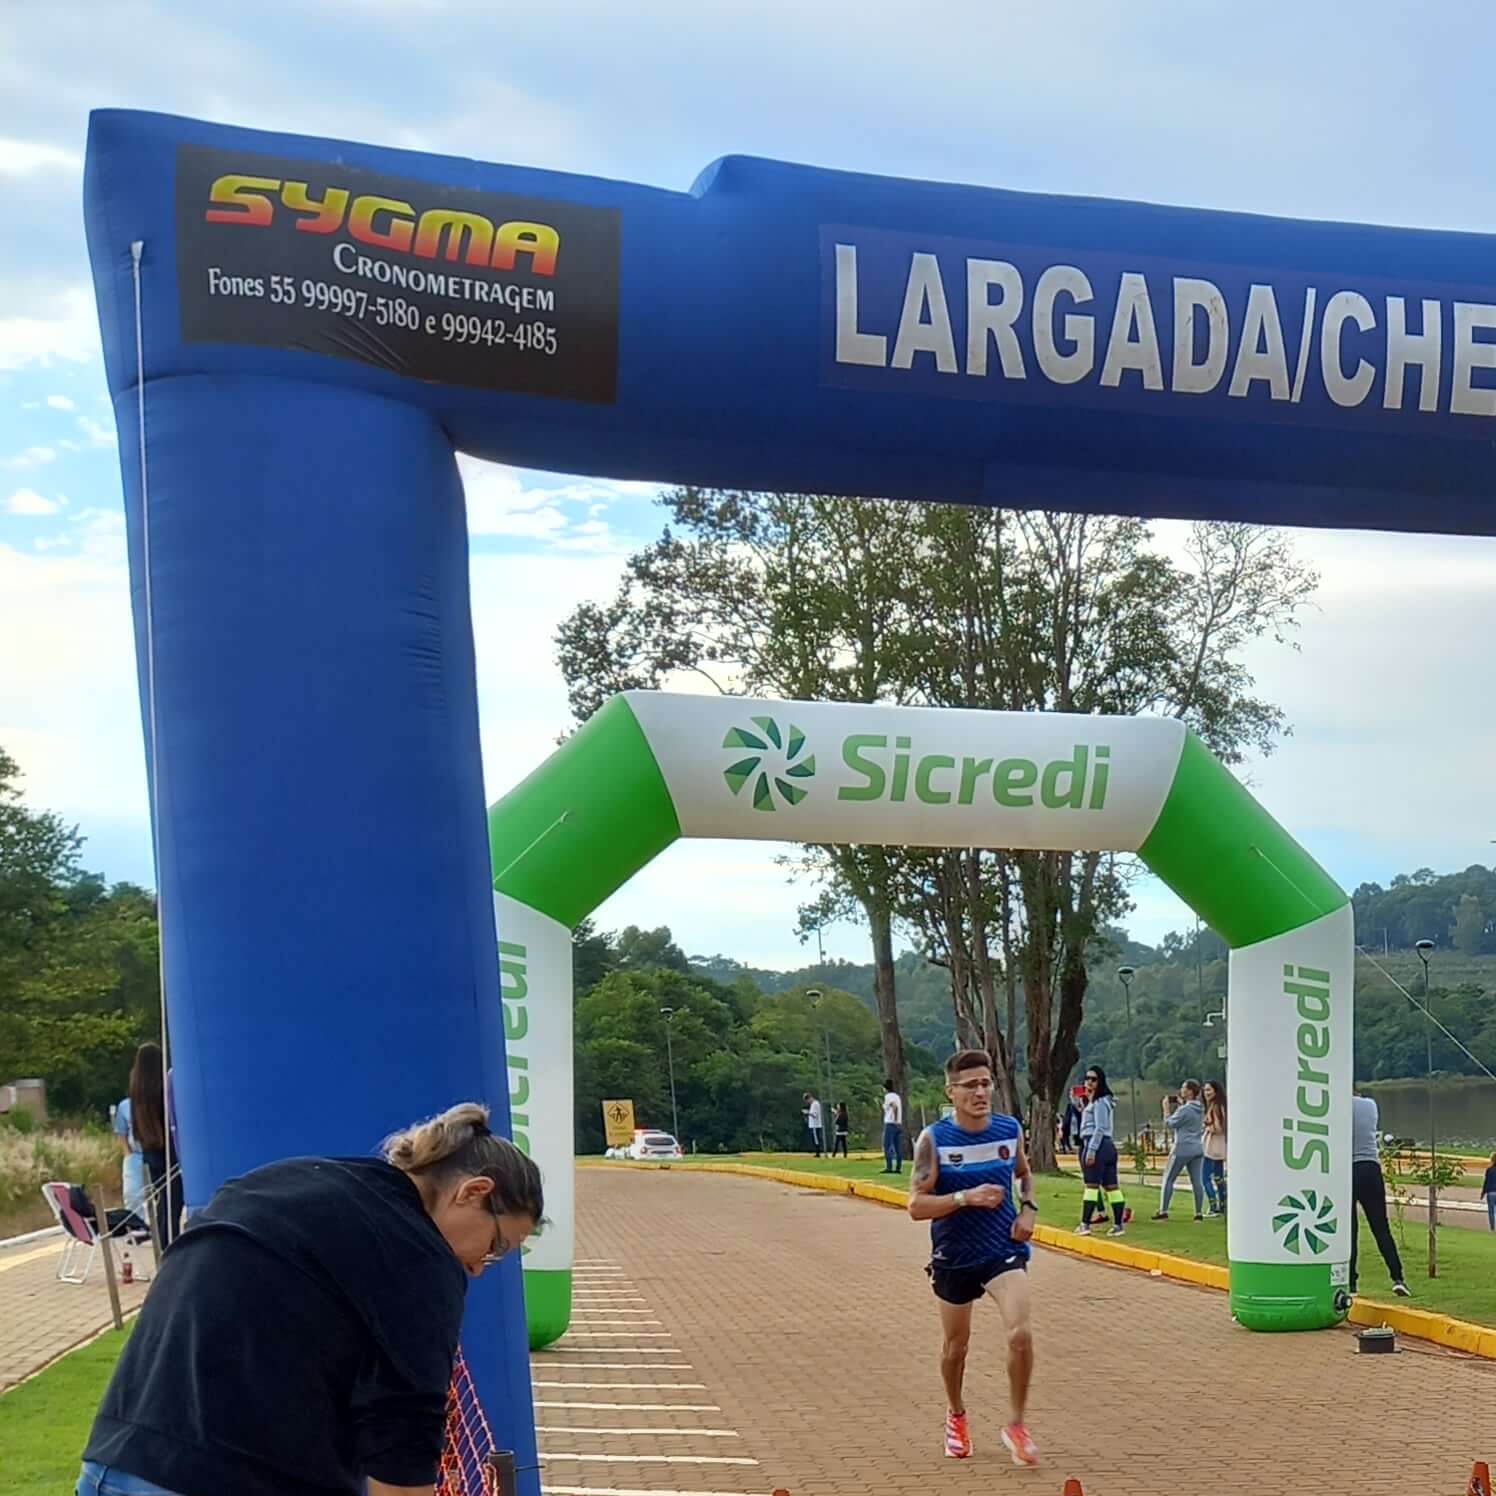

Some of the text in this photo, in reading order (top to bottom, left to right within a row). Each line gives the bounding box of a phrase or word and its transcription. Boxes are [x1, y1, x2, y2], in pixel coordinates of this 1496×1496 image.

[206, 174, 561, 277] SYGMA
[208, 268, 557, 355] Fones 55 99997-5180 e 99942-4185
[333, 243, 555, 314] CRONOMETRAGEM
[837, 733, 1111, 811] Sicredi
[1282, 963, 1331, 1175] Sicredi
